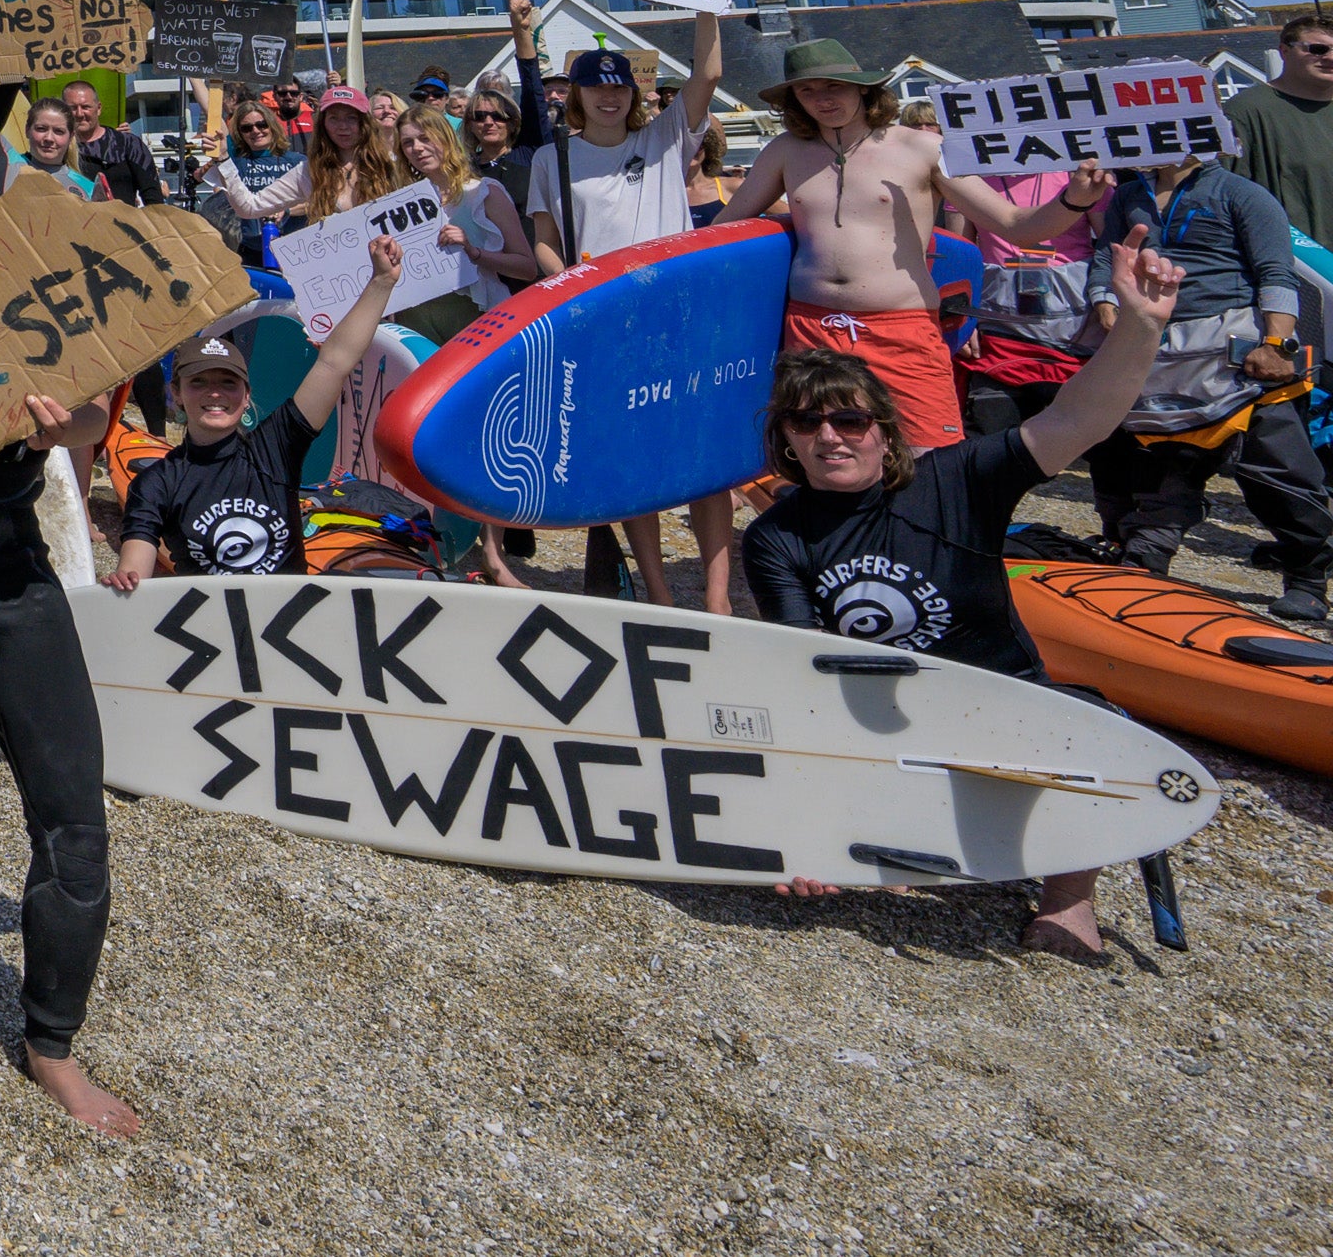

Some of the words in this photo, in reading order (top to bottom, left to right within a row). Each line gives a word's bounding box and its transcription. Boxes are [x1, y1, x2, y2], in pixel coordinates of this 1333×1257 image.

[161, 18, 226, 31] WATER
[164, 1, 213, 16] SOUTH
[223, 4, 259, 18] WEST
[24, 26, 138, 72] Faeces!
[160, 34, 210, 46] BREWING
[176, 48, 204, 63] CO.
[940, 73, 1106, 129] FISH
[1113, 74, 1206, 107] NOT
[971, 115, 1222, 165] FAECES
[280, 228, 359, 266] We've
[370, 197, 439, 235] TURD
[1, 217, 193, 367] SEA!
[628, 380, 672, 410] PACE
[715, 356, 757, 386] TOUR
[553, 357, 578, 485] AquaPlanet
[192, 497, 270, 535] SURFERS
[894, 581, 952, 651] SEWAGE
[154, 583, 446, 705] SICK
[497, 604, 711, 739] OF
[192, 698, 785, 873] SEWAGE
